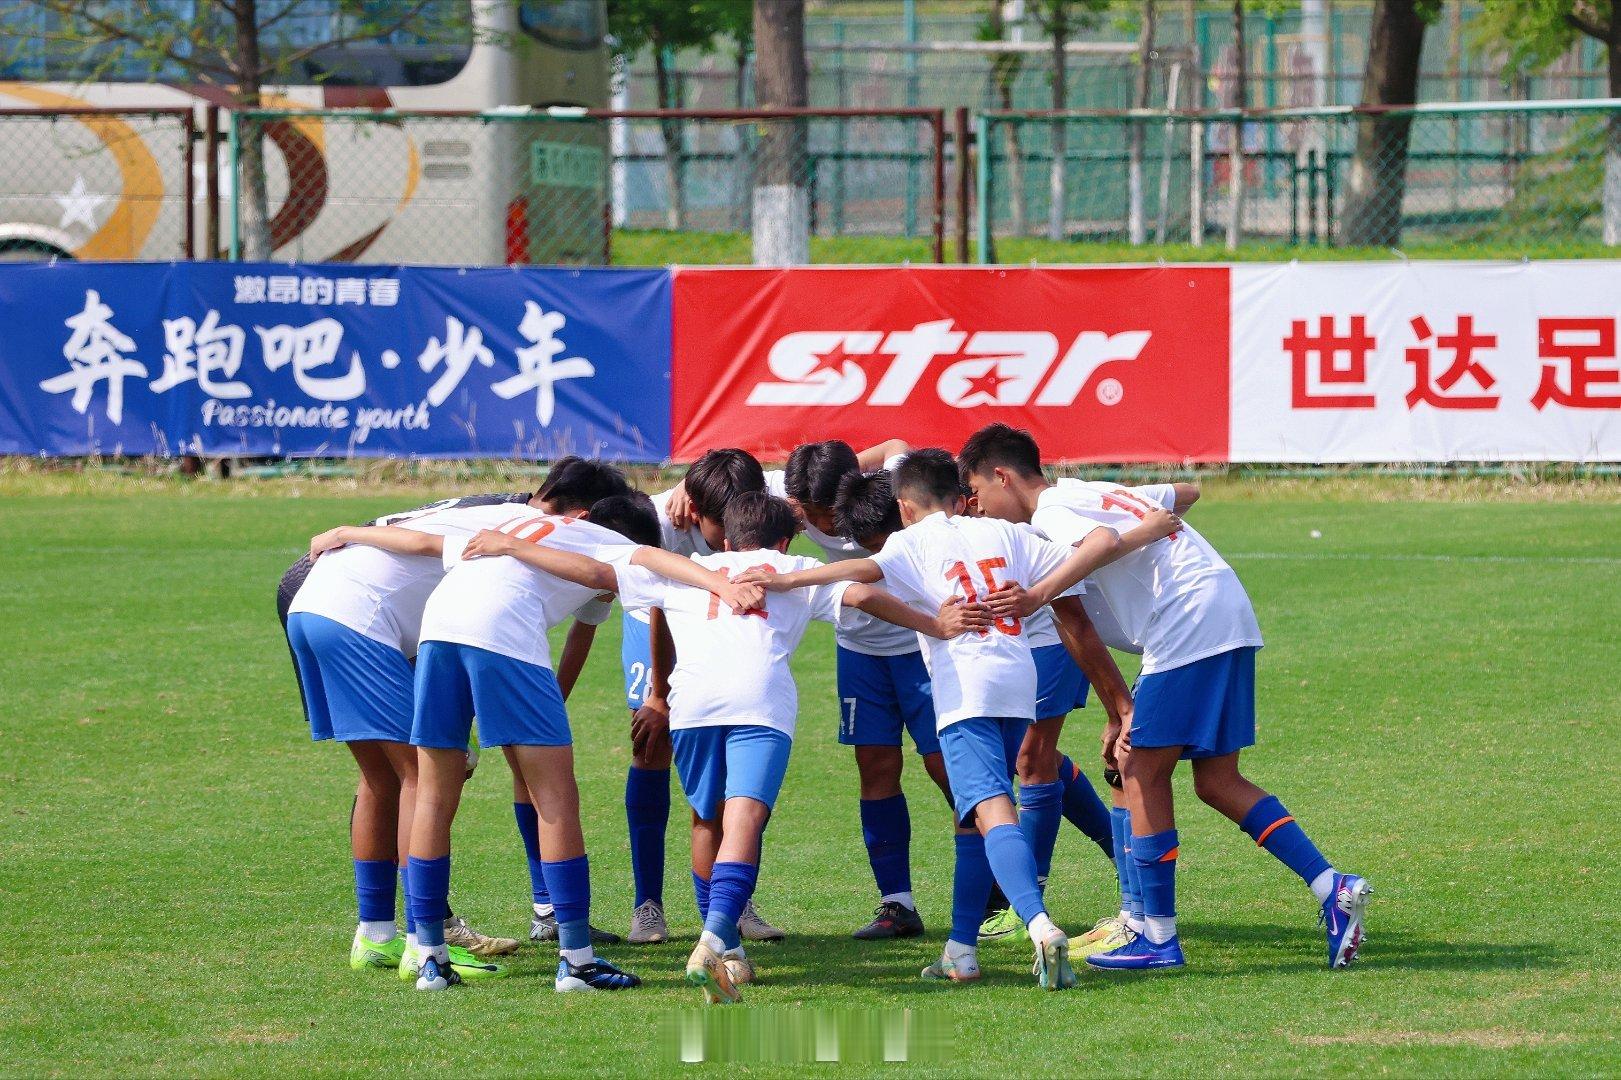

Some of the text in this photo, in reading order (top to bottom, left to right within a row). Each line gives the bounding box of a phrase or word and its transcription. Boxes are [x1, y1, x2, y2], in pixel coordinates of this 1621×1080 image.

[233, 275, 400, 306] 激昂的青春
[1282, 315, 1621, 411] 世达足
[201, 399, 431, 444] Passionate youth
